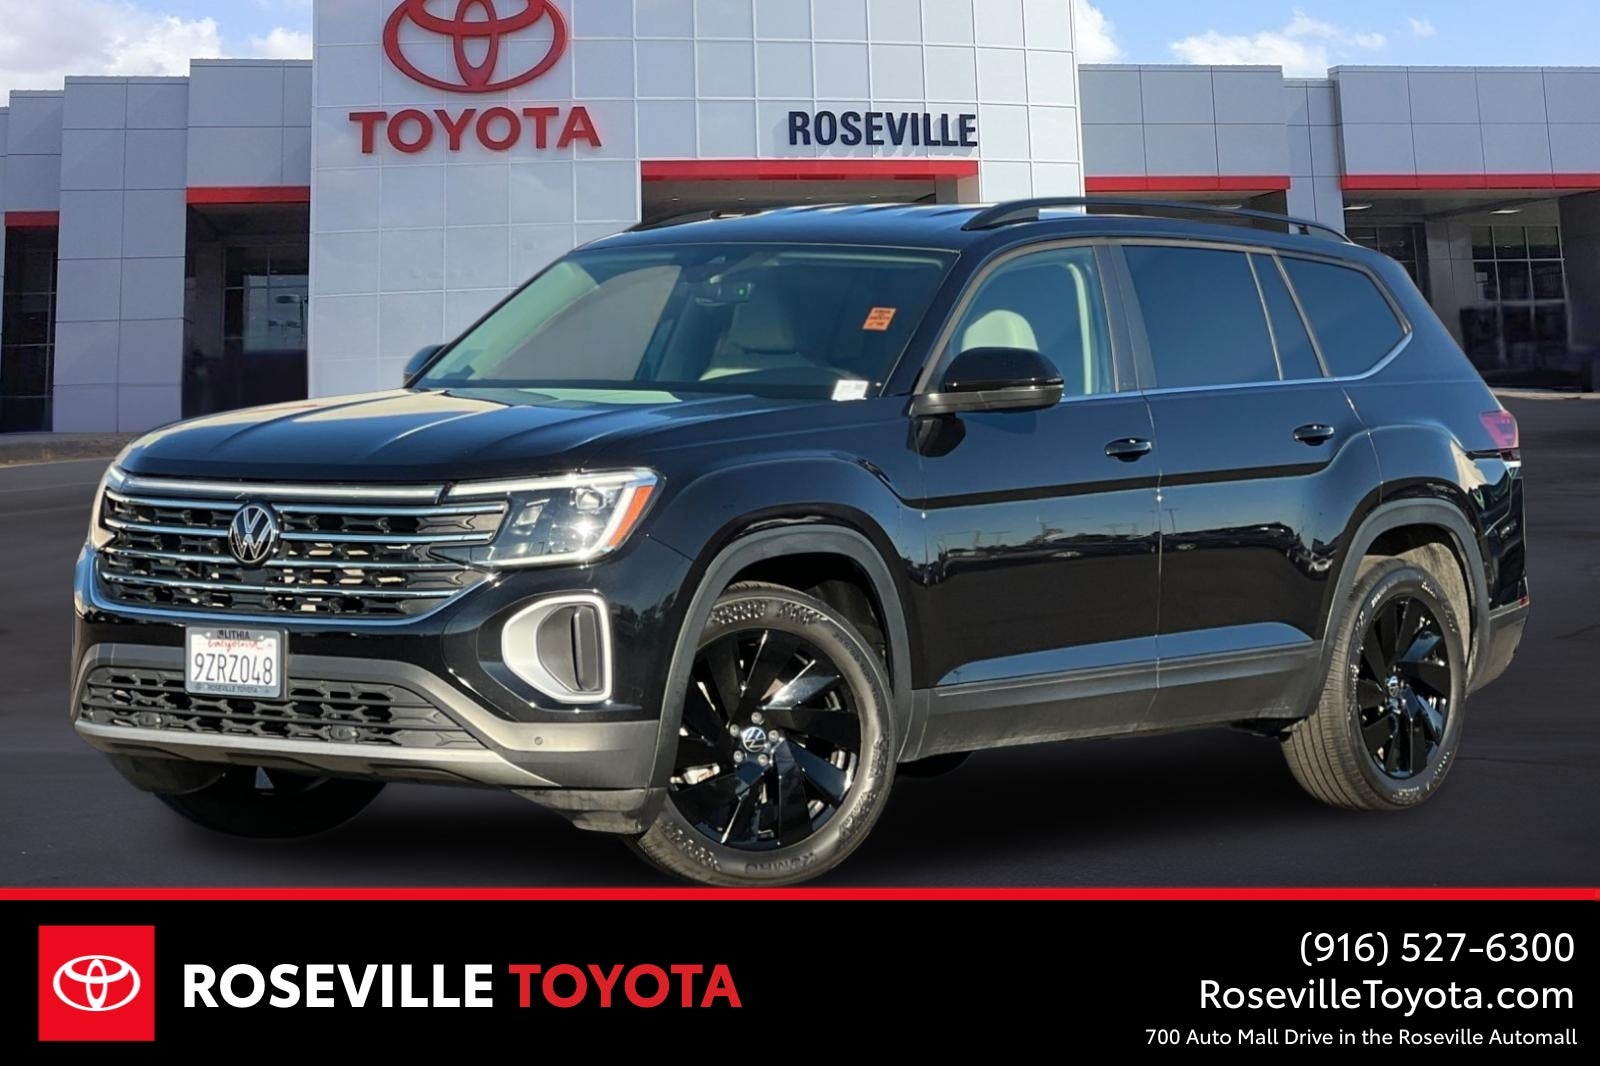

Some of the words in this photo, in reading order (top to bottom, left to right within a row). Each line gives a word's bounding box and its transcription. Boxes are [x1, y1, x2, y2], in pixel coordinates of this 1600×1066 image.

[349, 106, 602, 154] TOYOTA
[788, 110, 978, 147] ROSEVILLE
[224, 629, 250, 640] LITHIA
[194, 652, 273, 685] 9ZRZ048
